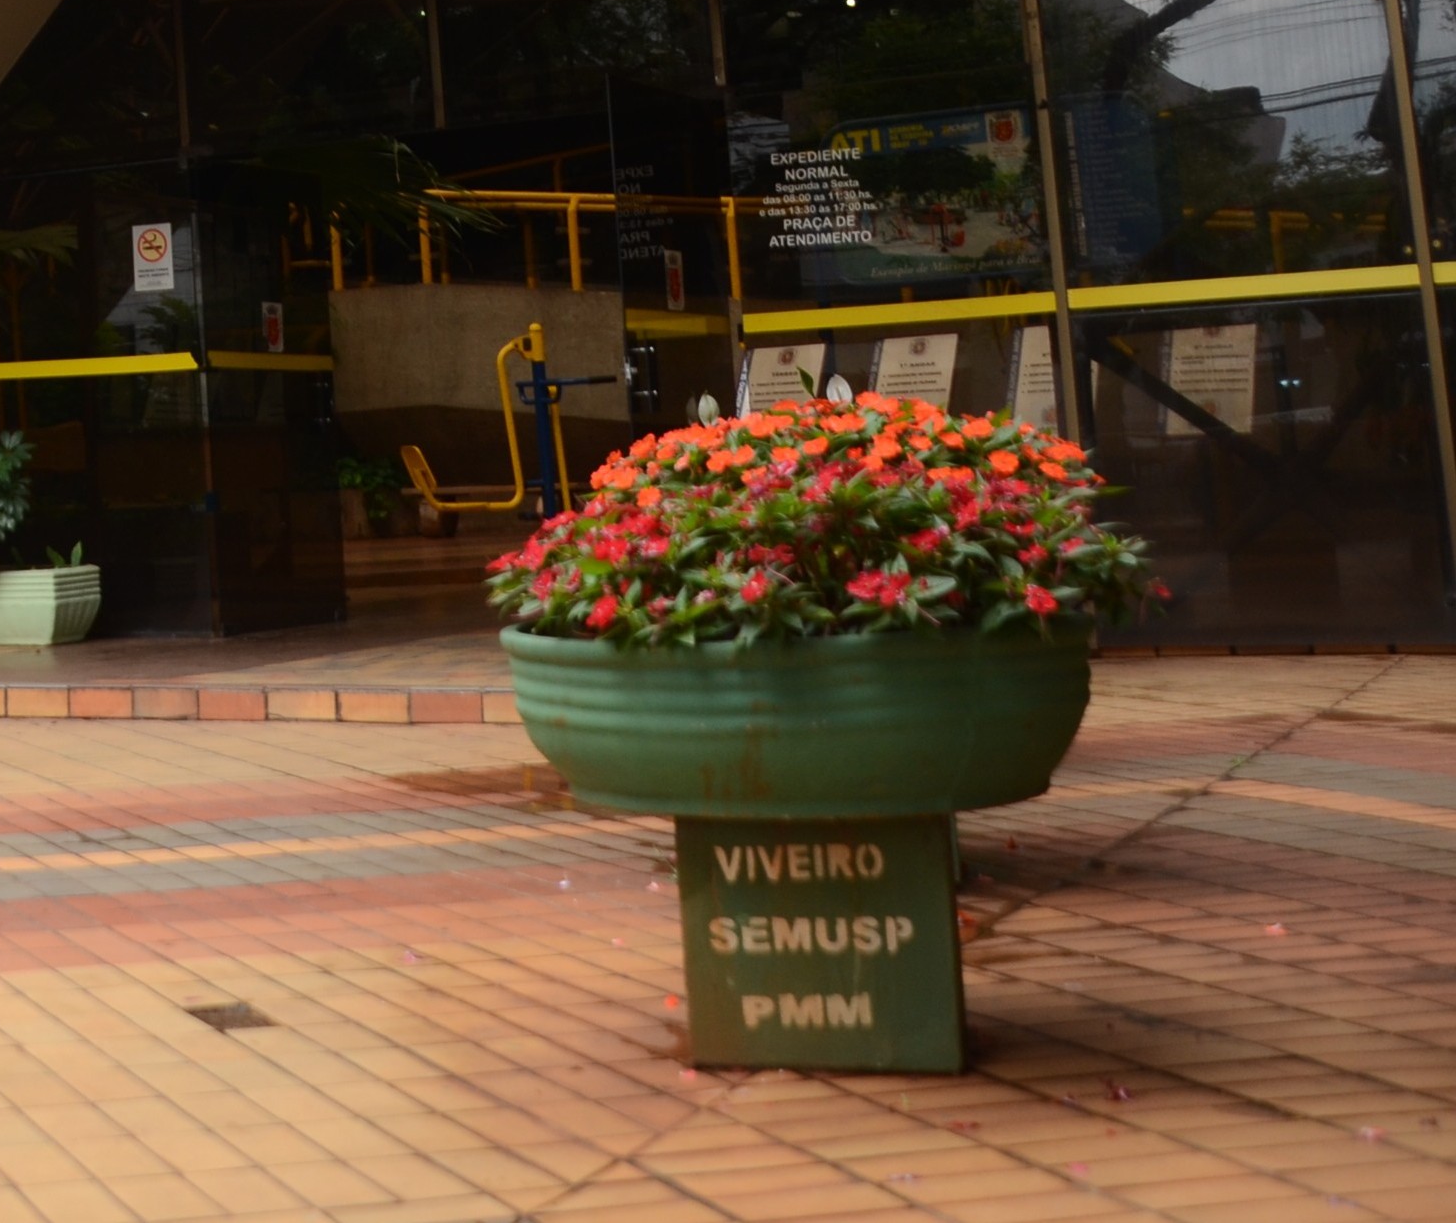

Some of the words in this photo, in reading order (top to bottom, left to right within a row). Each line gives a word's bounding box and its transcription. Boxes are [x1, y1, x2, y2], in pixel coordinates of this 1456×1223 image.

[770, 147, 862, 166] EXPEDIENTE
[784, 165, 849, 181] NORMAL
[774, 181, 820, 193] Segunda
[822, 181, 829, 189] a
[830, 178, 860, 188] Sexta
[762, 195, 781, 205] das
[783, 193, 812, 203] 08:00
[828, 190, 857, 200] 11:30
[759, 208, 766, 217] e
[767, 205, 787, 216] das
[789, 204, 816, 215] 13:30
[833, 201, 861, 212] 17:00
[783, 216, 833, 232] PRAÇA
[836, 214, 856, 228] DE
[768, 229, 872, 248] ATENDIMENTO
[713, 843, 884, 882] VIVEIRO
[708, 915, 914, 955] SEMUSP
[741, 991, 873, 1028] PMM
